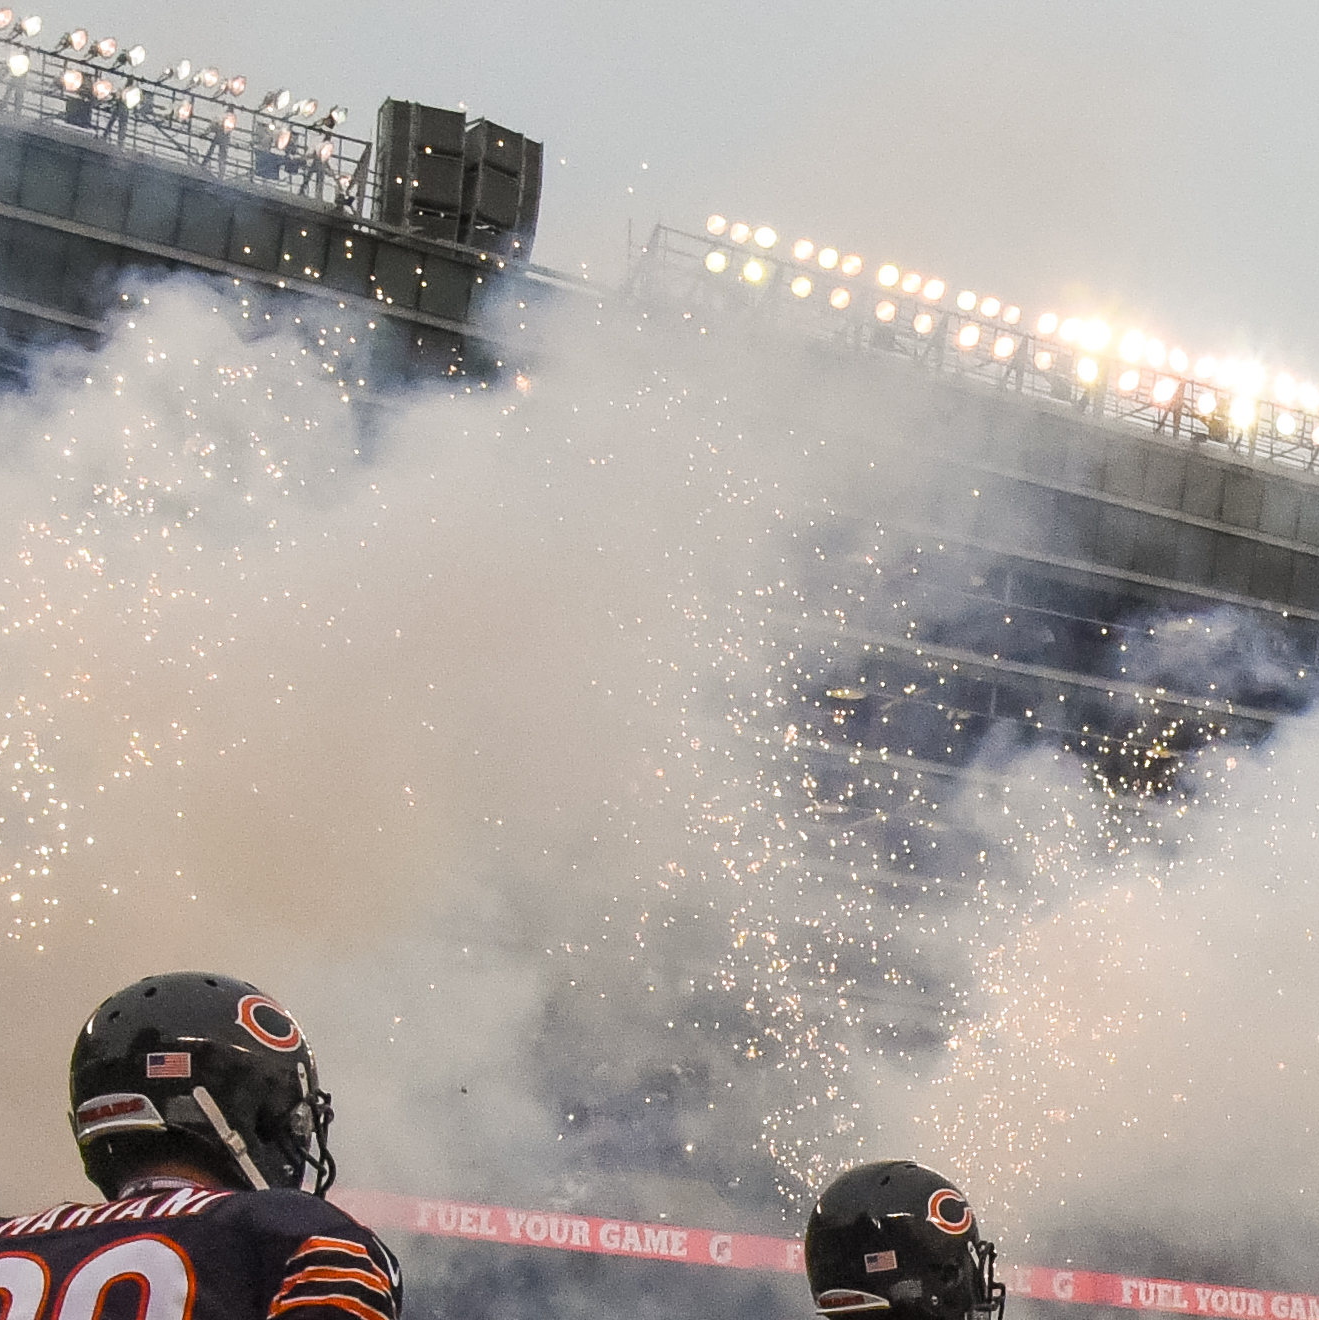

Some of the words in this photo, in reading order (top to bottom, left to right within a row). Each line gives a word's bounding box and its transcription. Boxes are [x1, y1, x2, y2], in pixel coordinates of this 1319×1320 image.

[416, 1202, 497, 1236] FUEL
[505, 1210, 591, 1247] YOUR
[599, 1222, 688, 1257] GAME
[1121, 1279, 1188, 1308] FUEL
[1195, 1287, 1266, 1317] YOUR
